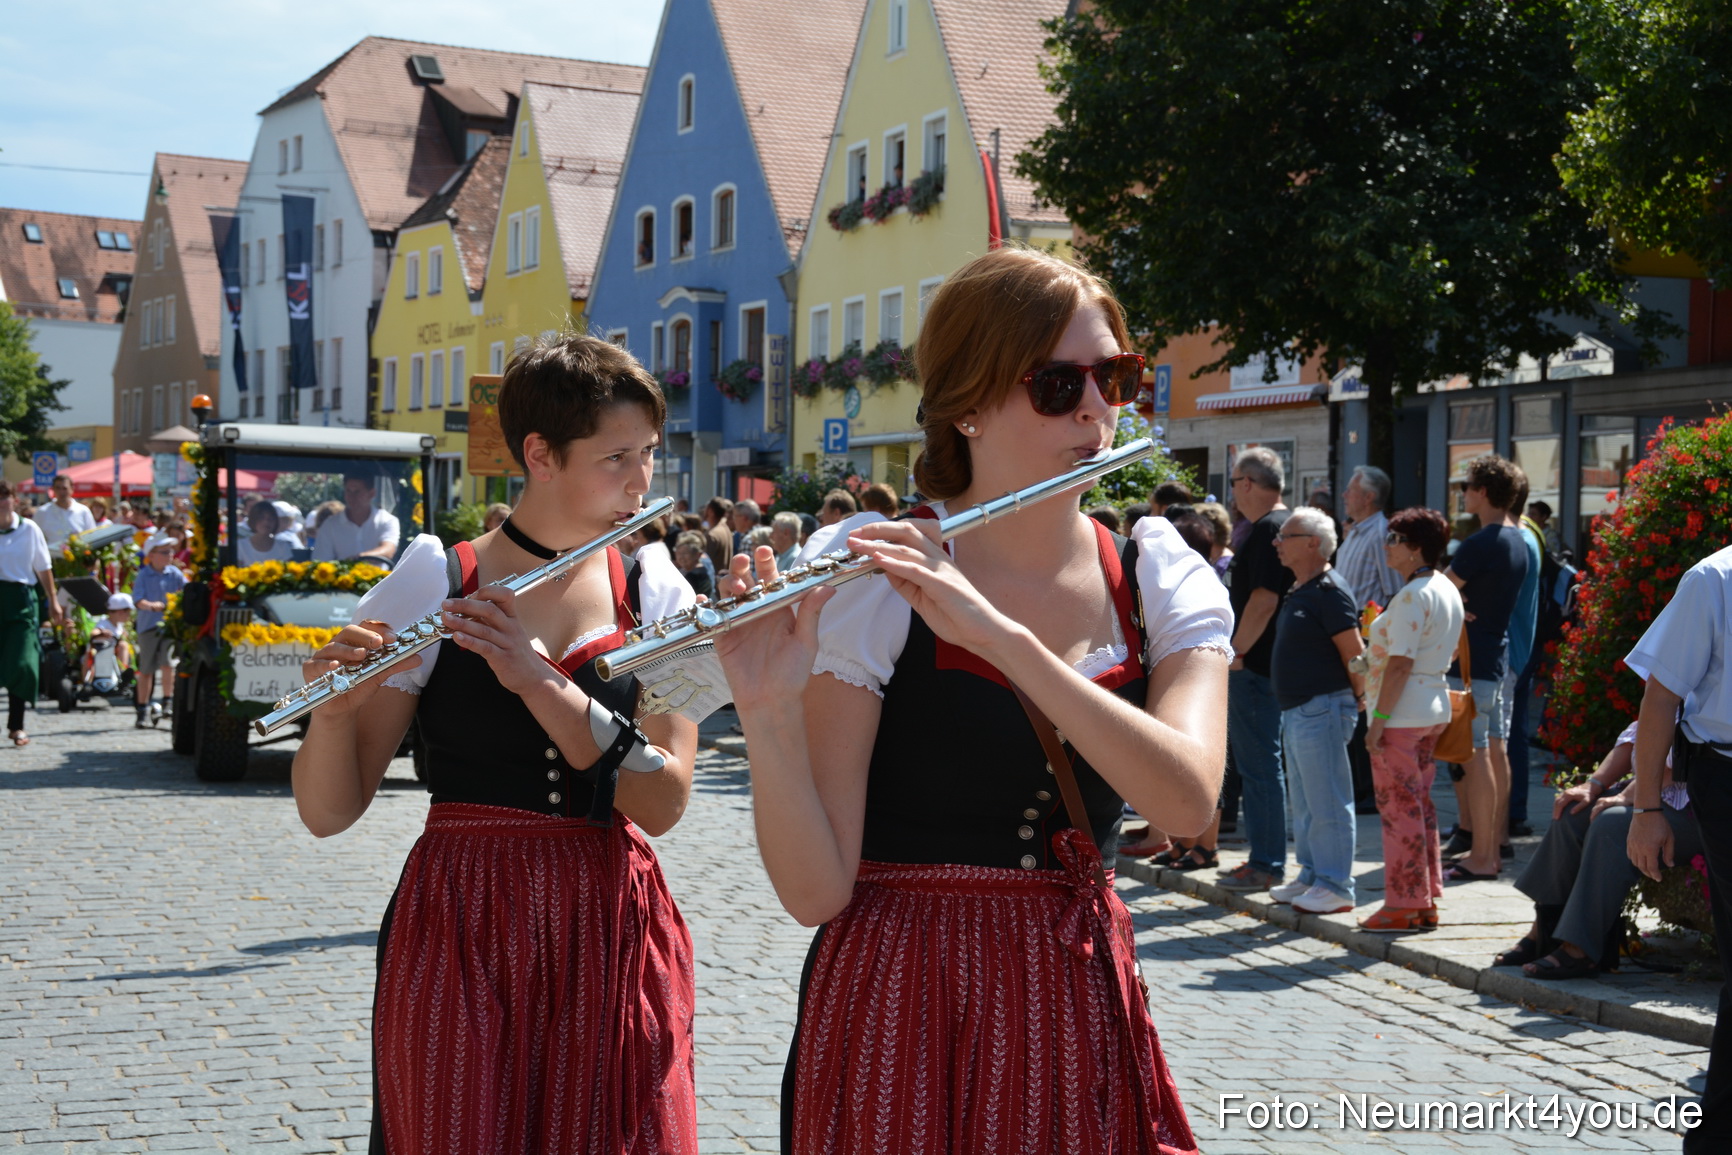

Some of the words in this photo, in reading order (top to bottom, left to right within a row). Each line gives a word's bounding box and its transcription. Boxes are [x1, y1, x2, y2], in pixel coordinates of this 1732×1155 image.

[287, 262, 309, 320] K&L
[417, 323, 442, 345] HOTEL
[828, 422, 844, 450] P
